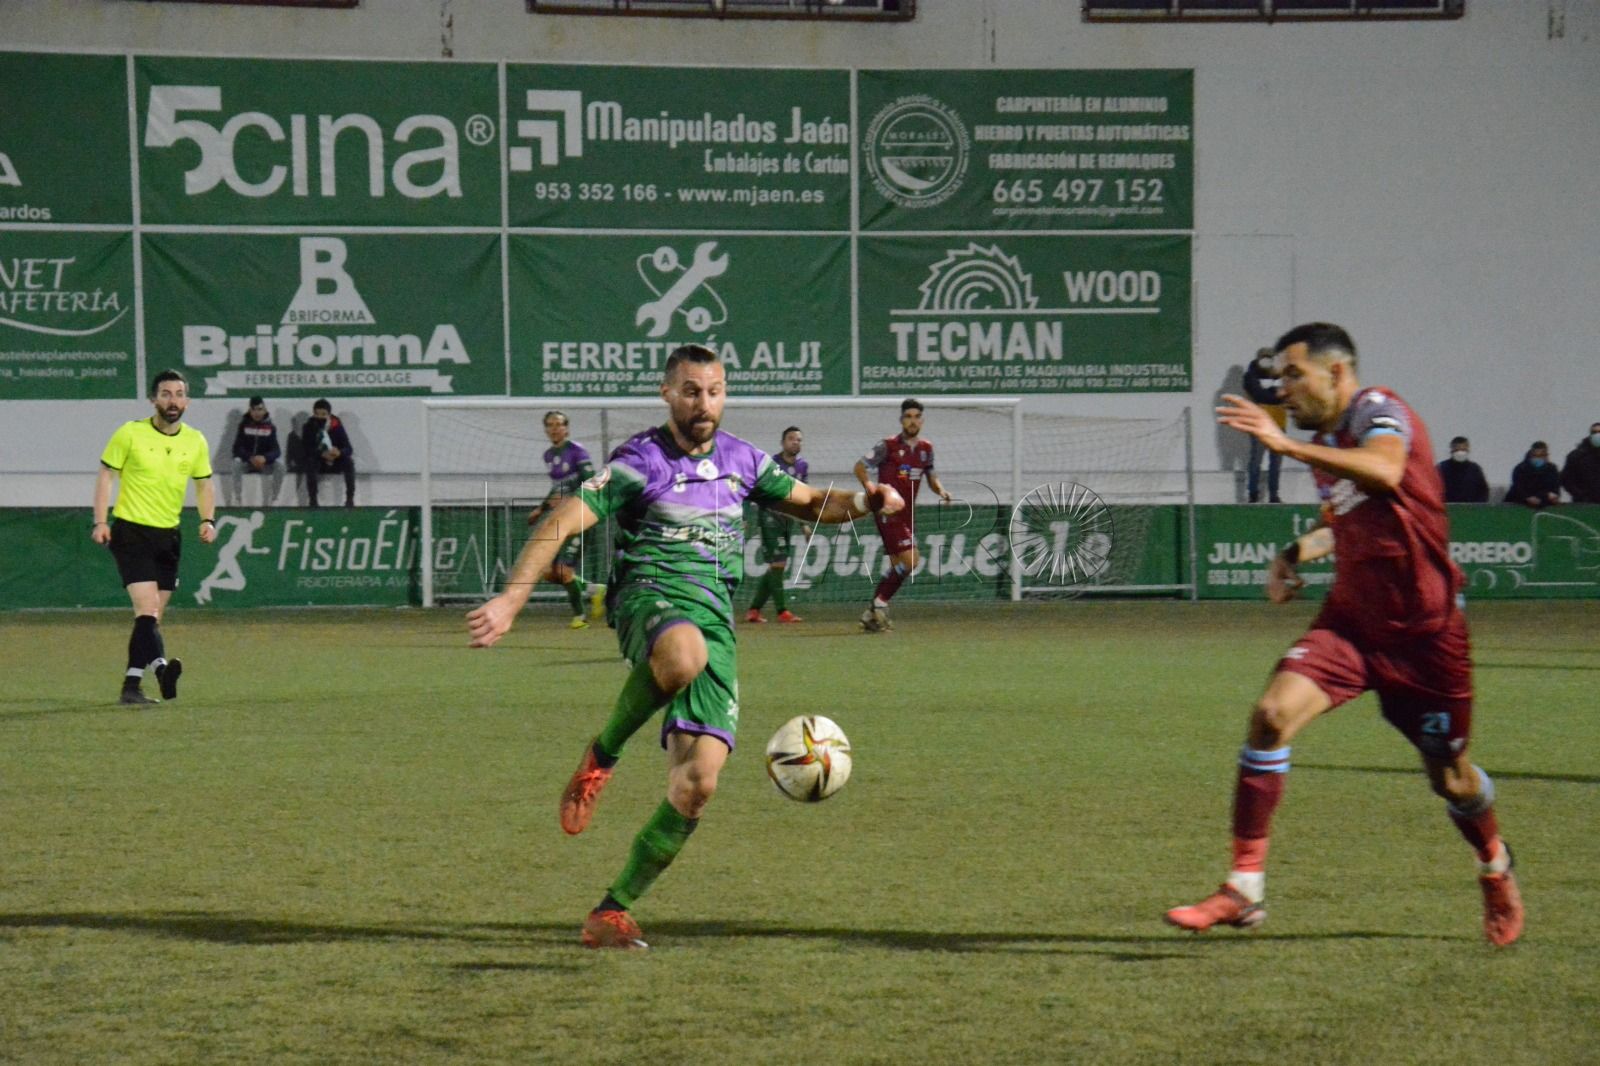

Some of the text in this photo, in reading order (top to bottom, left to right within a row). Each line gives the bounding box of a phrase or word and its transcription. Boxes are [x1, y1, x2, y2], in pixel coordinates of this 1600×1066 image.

[587, 101, 849, 149] Manipulados Jaén
[1036, 125, 1095, 141] PUERTAS
[704, 149, 780, 176] Embalajes
[783, 152, 801, 173] de
[535, 182, 571, 200] 953
[579, 183, 614, 200] 352
[622, 184, 657, 201] 166
[678, 186, 825, 206] www.mjaen.es
[992, 179, 1163, 202] 665 497 152
[1063, 270, 1161, 302] WOOD
[289, 309, 367, 322] BRIFORMA
[183, 324, 471, 366] BriformA
[542, 334, 821, 369] FERRETA ALJI
[890, 322, 1063, 362] TECMAN
[245, 372, 412, 386] FERRETERIA & BRICOLAGE
[542, 371, 634, 382] SUMINISTROS
[728, 371, 823, 381] INDUSTRIALES
[862, 362, 1188, 378] REPARACIÓN Y VENTA DE MAQUINARIA INDUSTRIAL
[277, 509, 458, 571] FisioÉlie
[1207, 542, 1276, 564] JUAN
